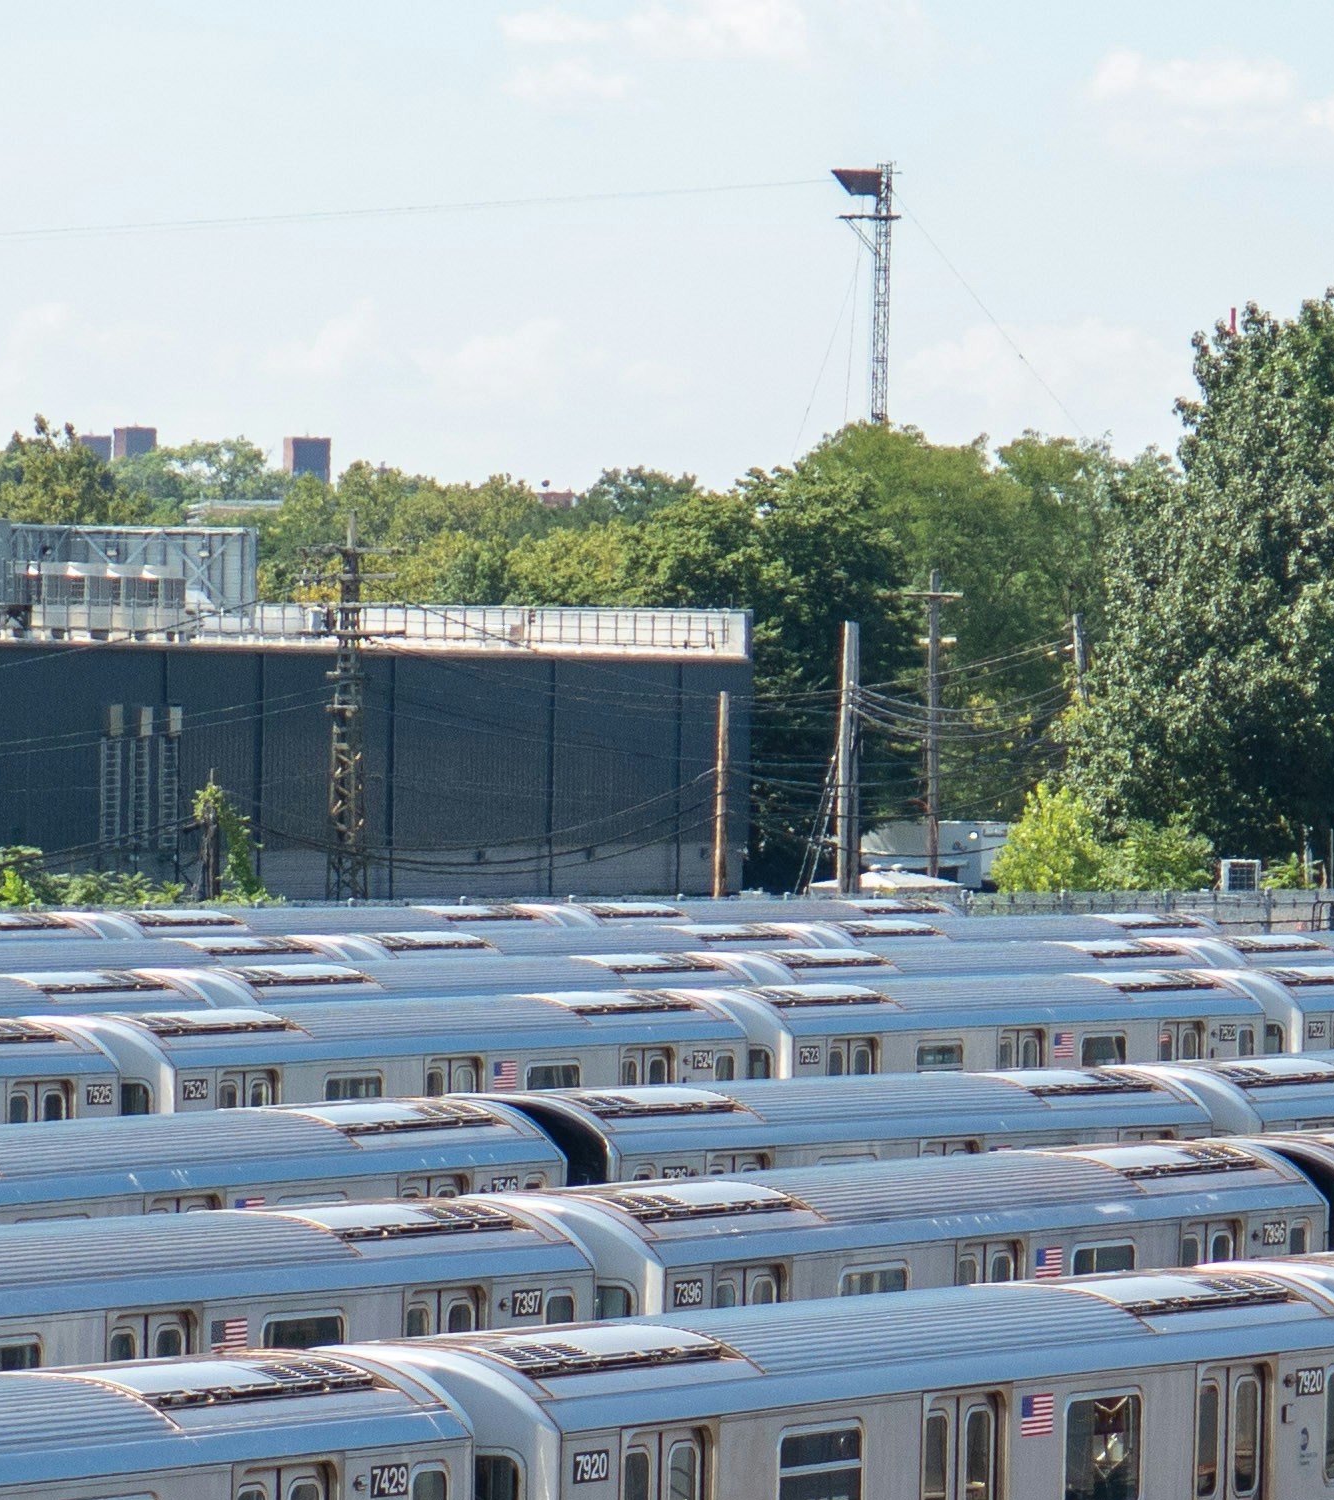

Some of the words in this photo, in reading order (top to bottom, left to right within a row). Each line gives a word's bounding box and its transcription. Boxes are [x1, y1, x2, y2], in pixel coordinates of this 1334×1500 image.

[692, 1051, 714, 1069] 7524
[799, 1046, 820, 1065] 7523
[86, 1084, 112, 1104] 7525
[183, 1079, 208, 1099] 7524
[1263, 1222, 1286, 1244] 7396
[513, 1291, 542, 1316] 7397
[675, 1281, 702, 1305] 7396
[1298, 1368, 1323, 1395] 7920
[575, 1453, 608, 1481] 7920
[372, 1466, 407, 1496] 7429
